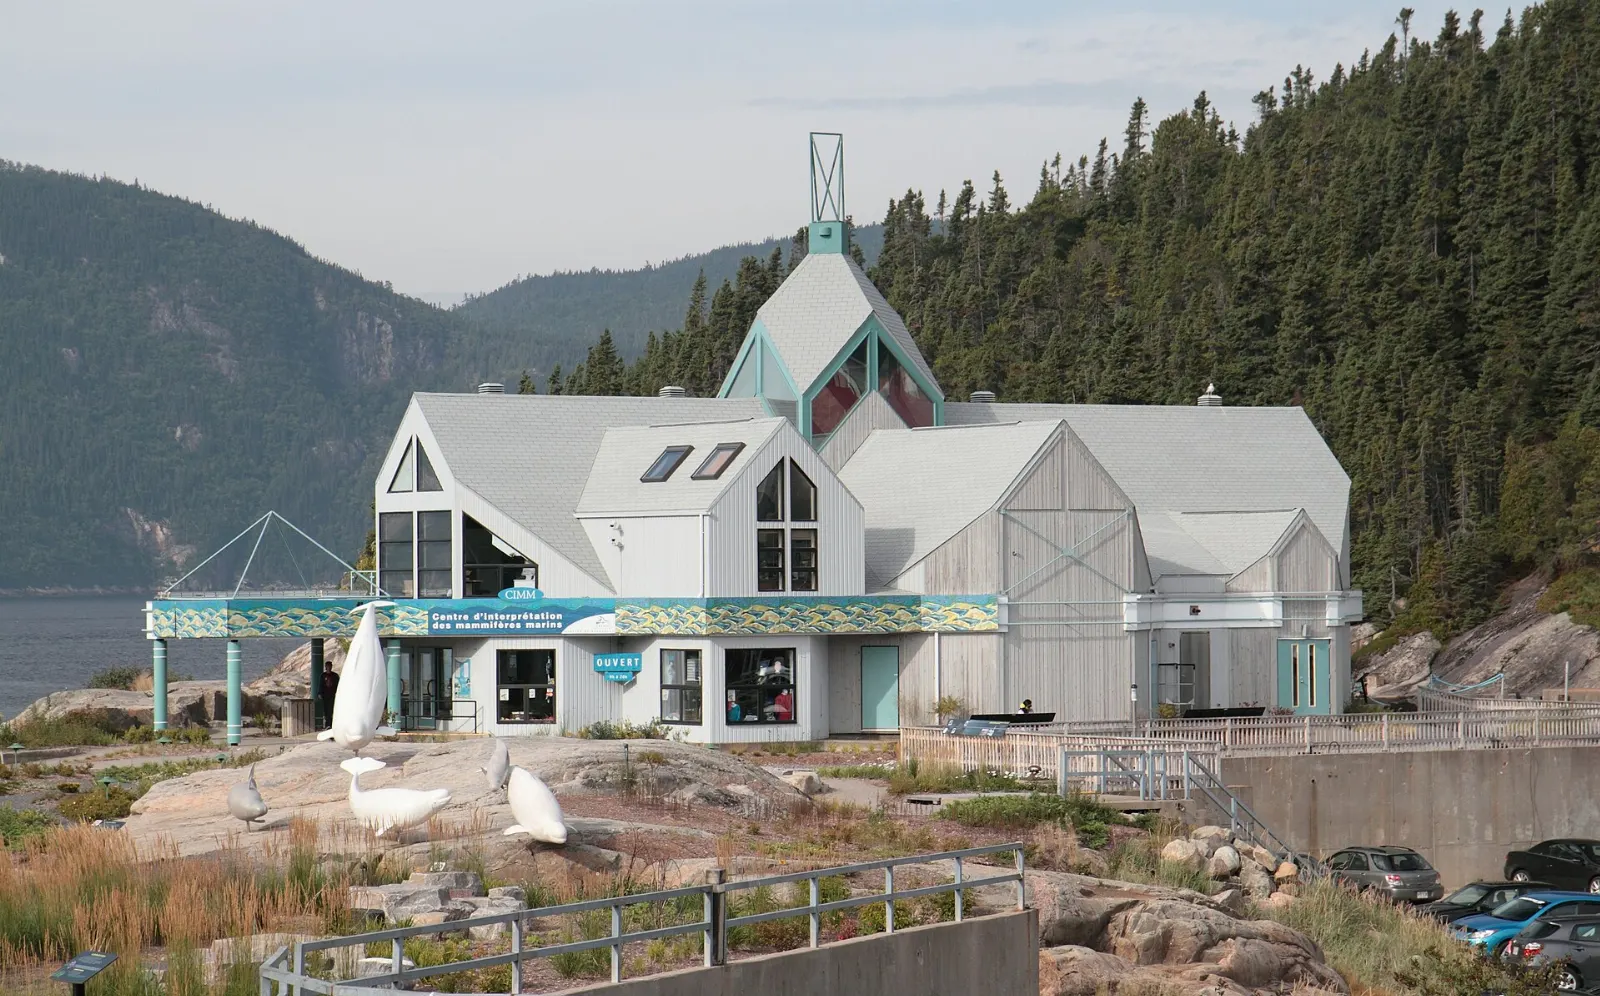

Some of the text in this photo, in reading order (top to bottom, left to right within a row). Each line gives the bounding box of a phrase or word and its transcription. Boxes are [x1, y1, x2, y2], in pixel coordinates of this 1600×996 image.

[505, 590, 536, 599] CIMM
[432, 612, 563, 622] Centre d'interprétation
[432, 621, 563, 629] des mammifères marins
[596, 658, 640, 667] OUVERT
